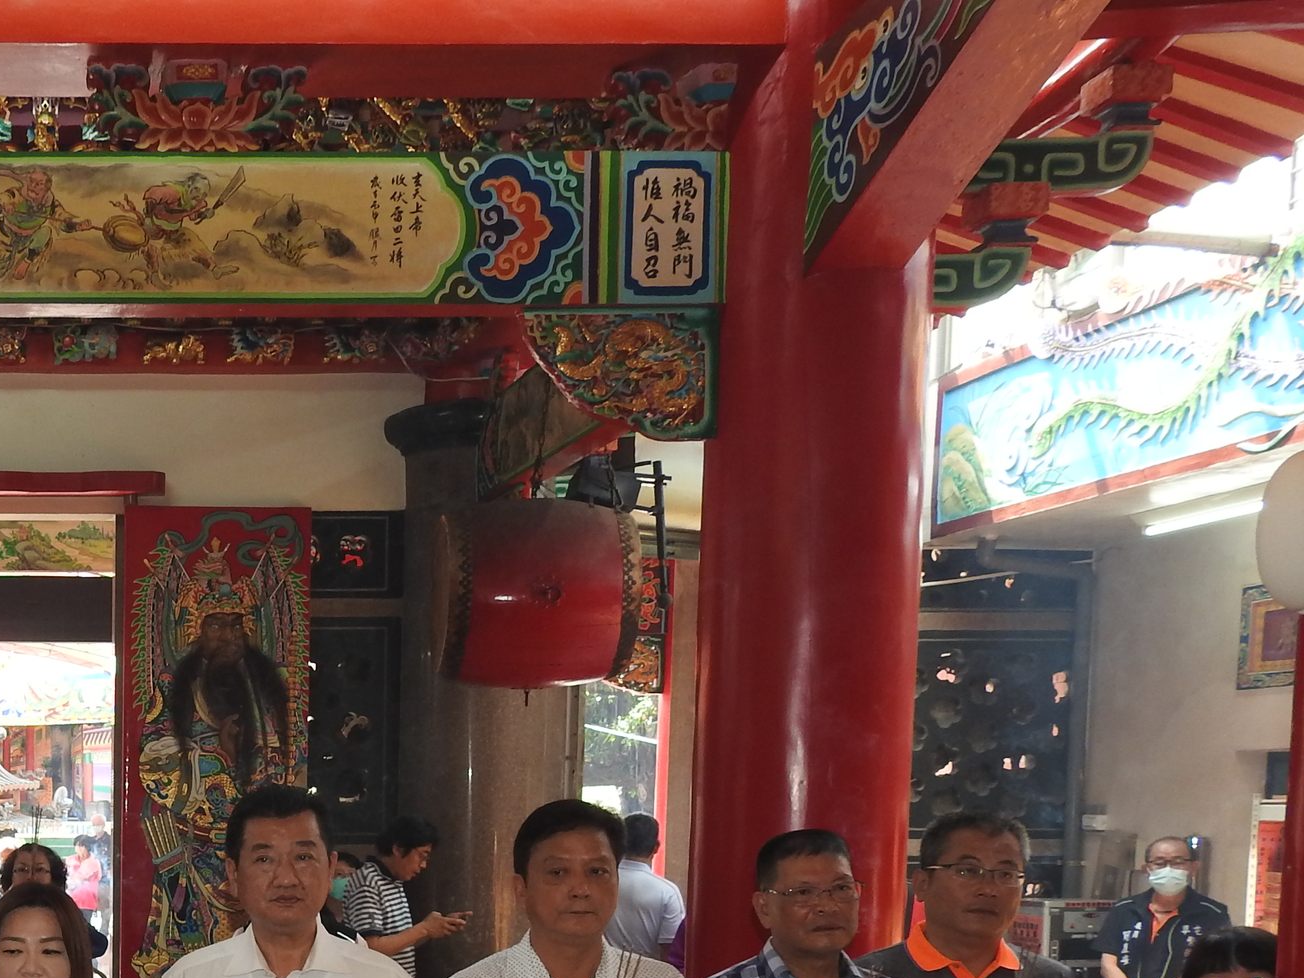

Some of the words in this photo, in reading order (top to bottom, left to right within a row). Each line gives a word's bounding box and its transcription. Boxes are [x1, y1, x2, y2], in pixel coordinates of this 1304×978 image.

[389, 174, 408, 269] 收伏雷田二將
[408, 171, 428, 238] 玄天上帝
[641, 175, 665, 279] 惟人自召
[671, 176, 698, 279] 禍福無門
